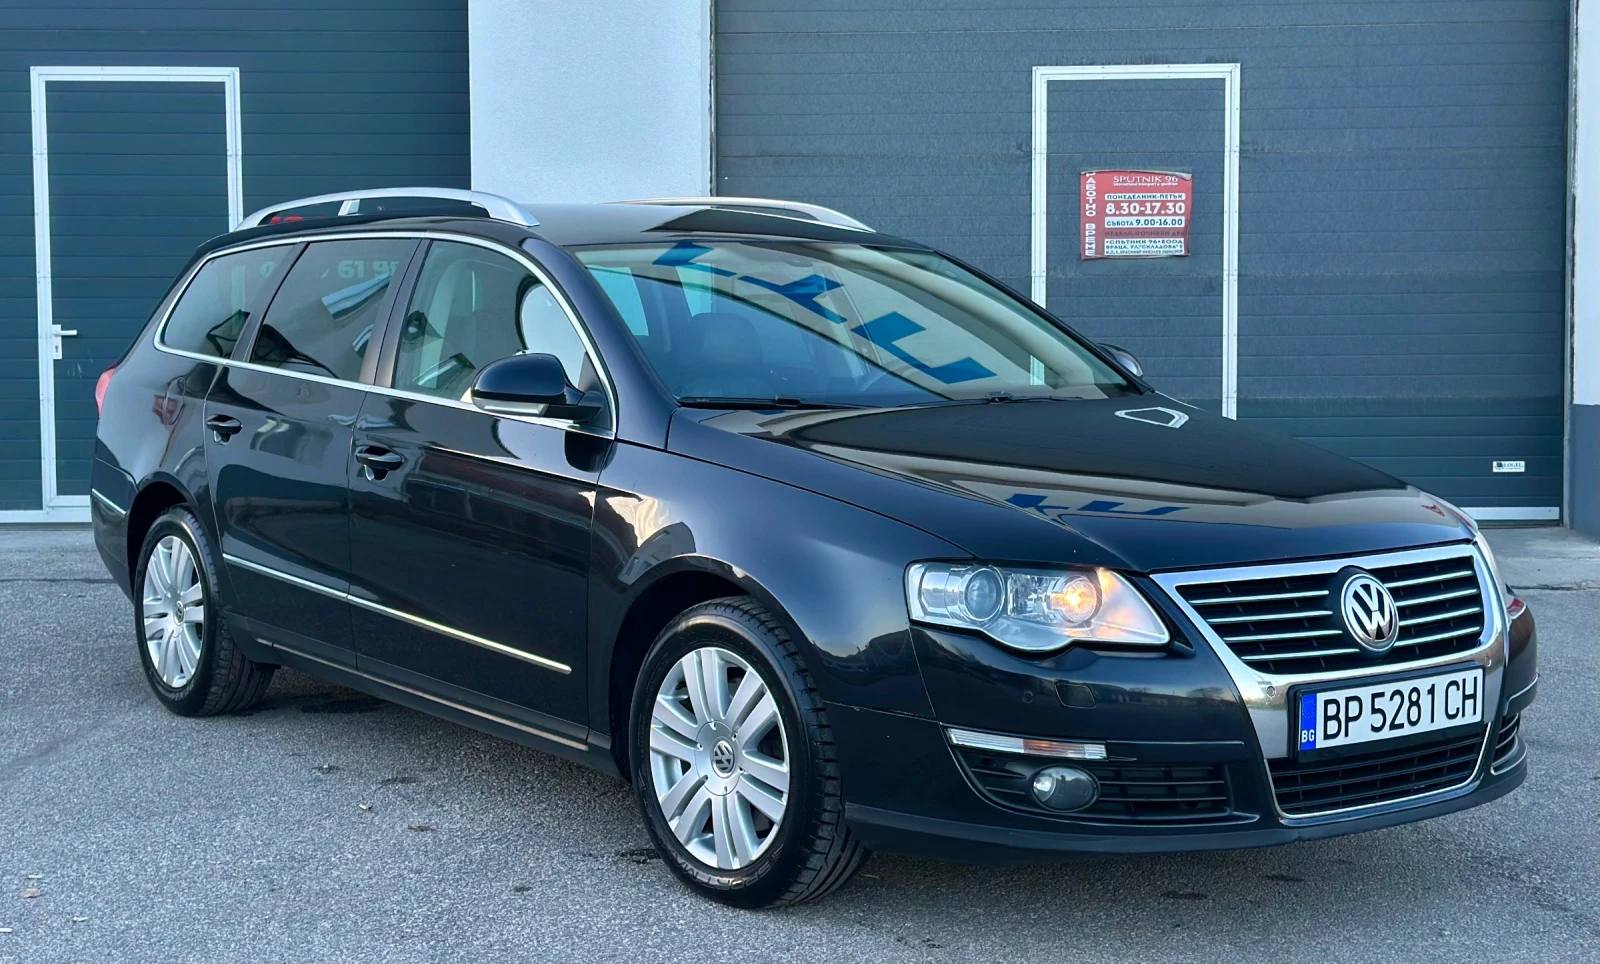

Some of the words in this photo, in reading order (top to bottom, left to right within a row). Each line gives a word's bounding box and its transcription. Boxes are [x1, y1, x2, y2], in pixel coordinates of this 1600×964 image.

[1113, 175, 1162, 183] SPUTNIK
[1165, 175, 1179, 183] 96
[1105, 202, 1186, 214] 8.30-17.30
[1135, 218, 1183, 226] 9.00-16.00
[1085, 223, 1096, 256] ВРЕМЕ
[1323, 695, 1363, 741] BP
[1370, 683, 1436, 733] 5281
[1444, 676, 1478, 720] CH
[1301, 729, 1315, 743] BG
[700, 861, 771, 890] SPORT
